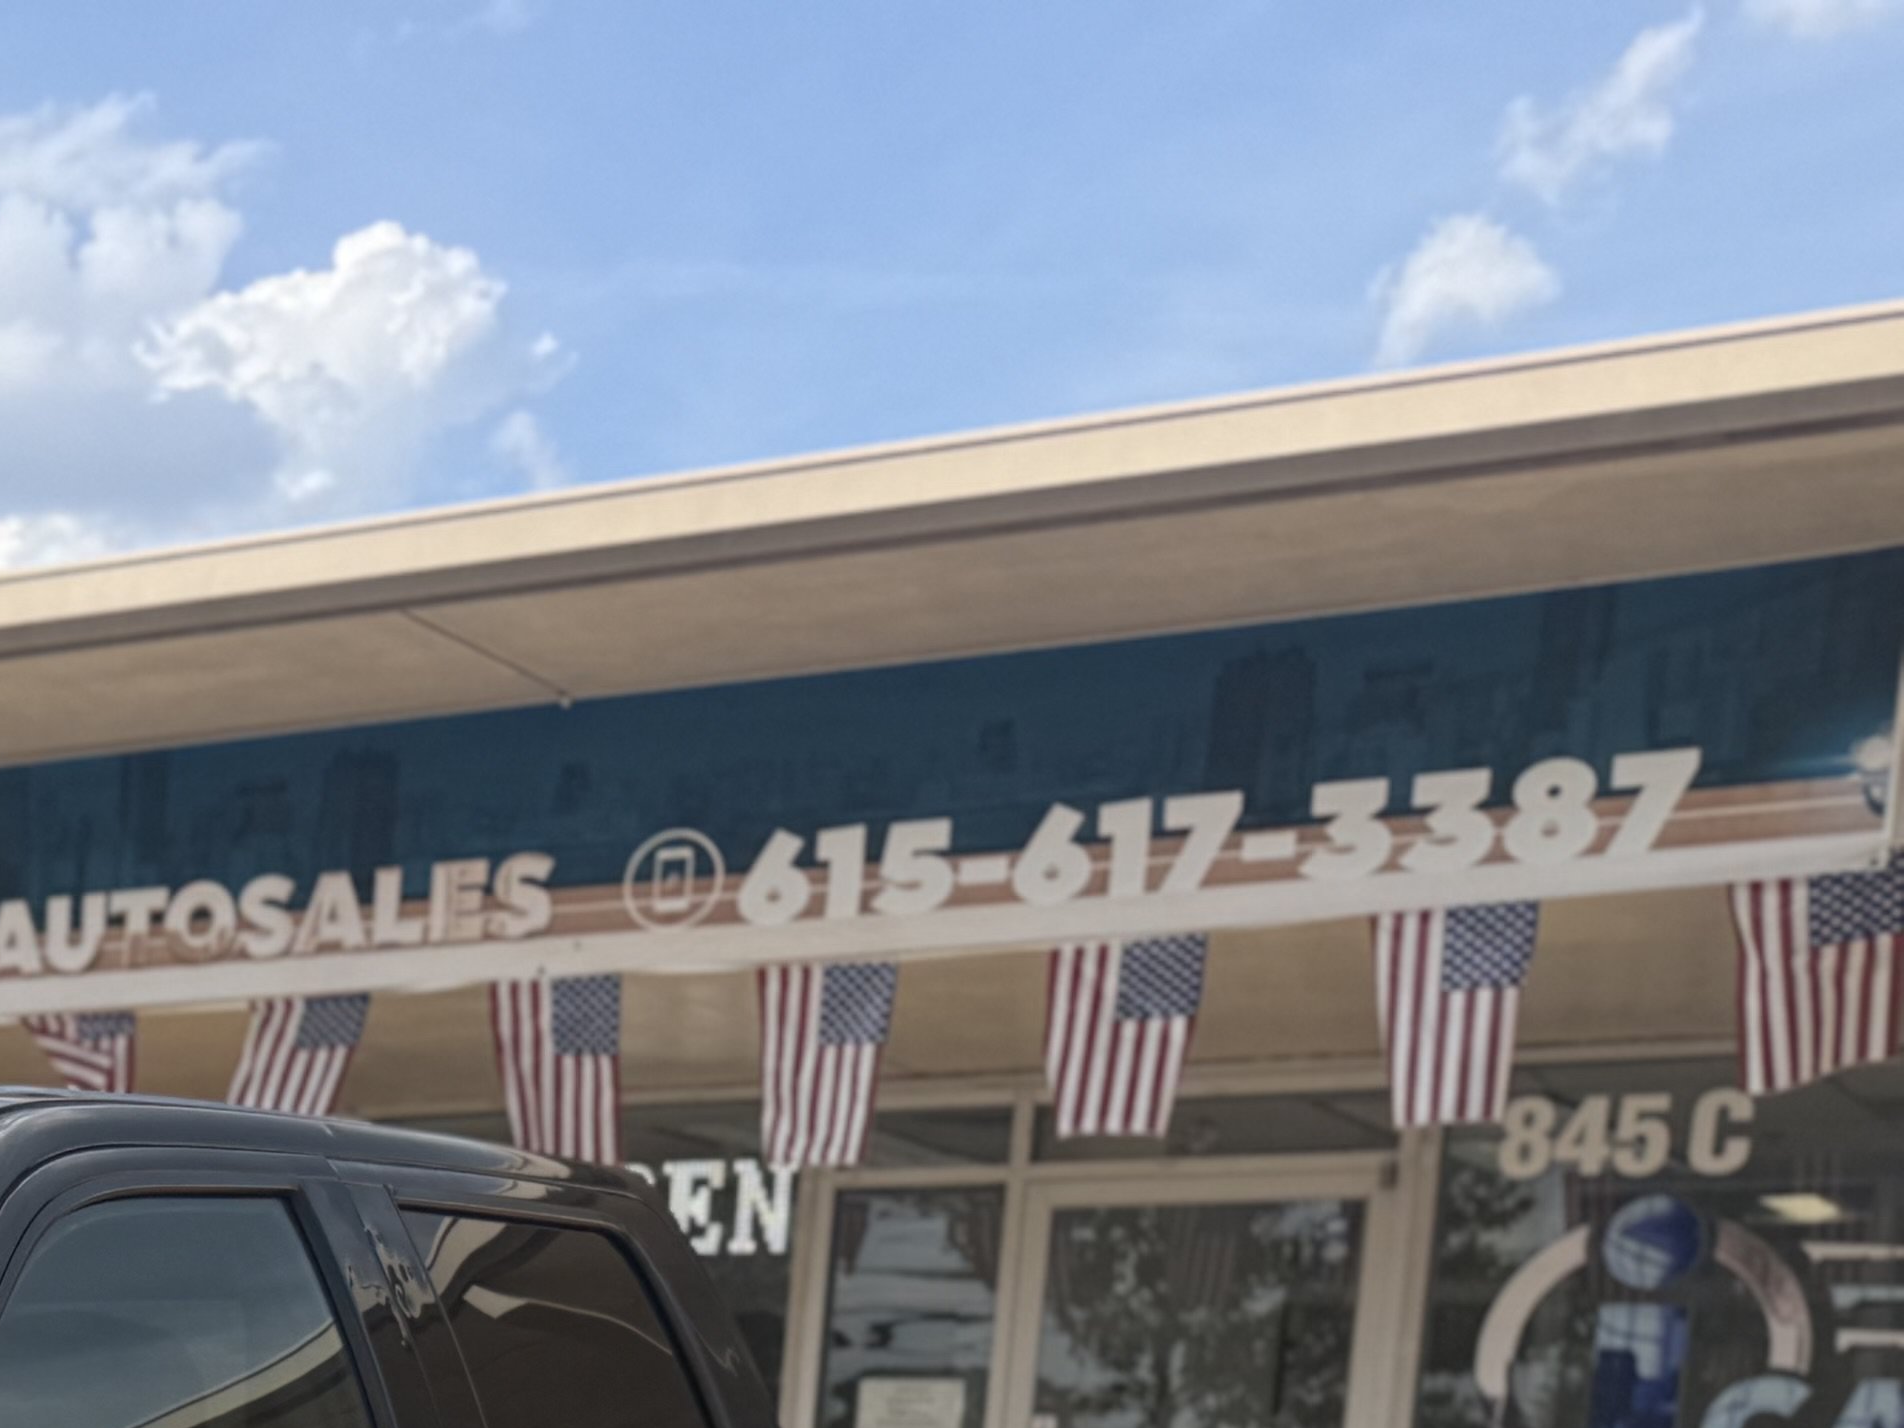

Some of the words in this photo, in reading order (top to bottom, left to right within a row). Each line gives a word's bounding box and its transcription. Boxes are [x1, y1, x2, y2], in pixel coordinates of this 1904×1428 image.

[735, 746, 1702, 928] 615-617-3387
[1496, 1091, 1673, 1180] 845
[1686, 1086, 1756, 1178] C
[625, 1158, 799, 1257] EN
